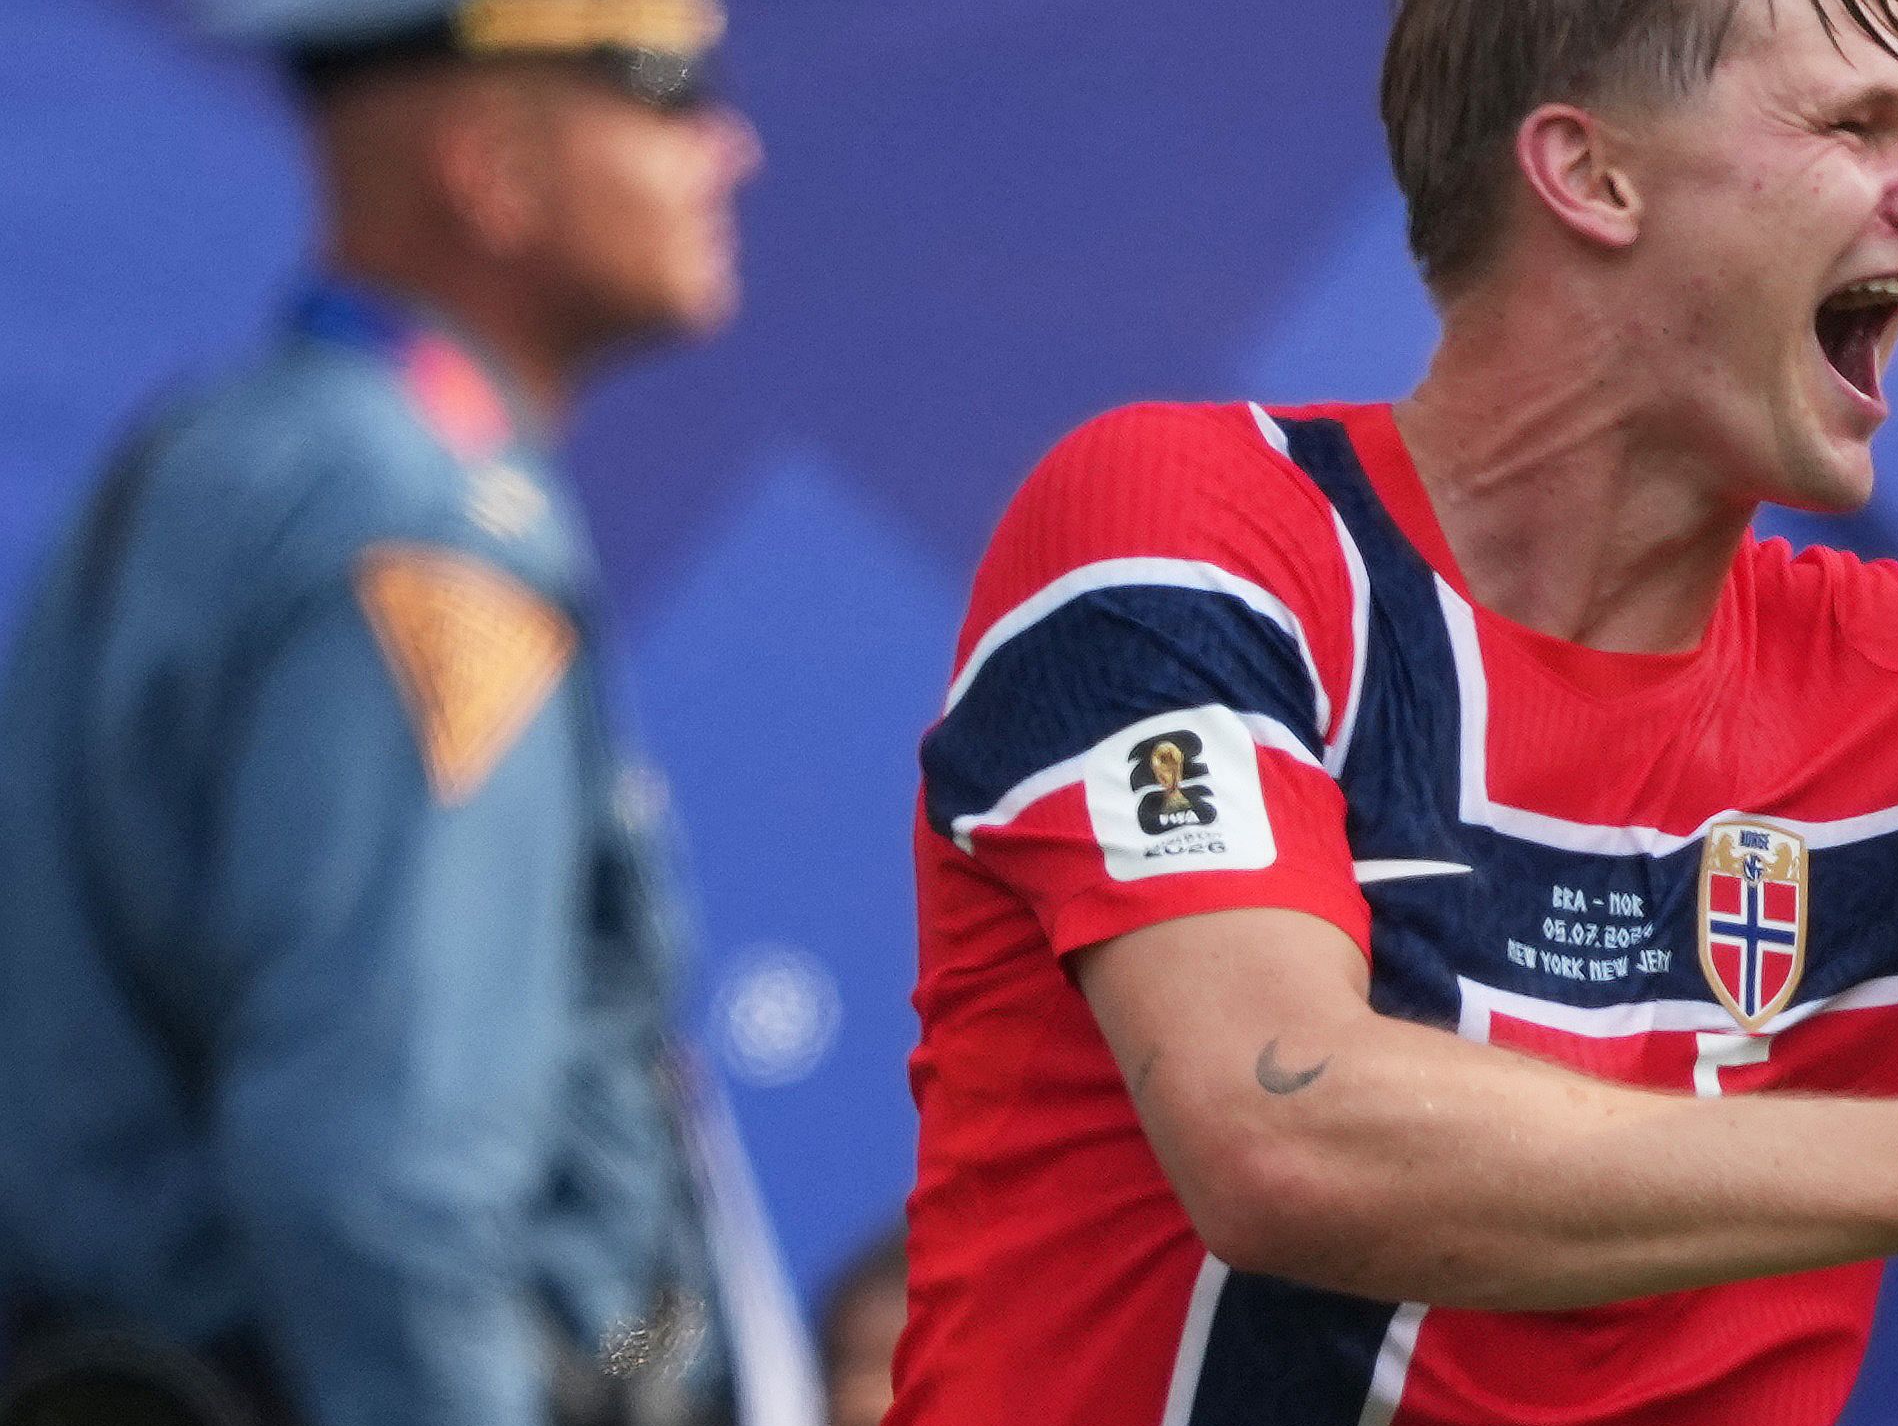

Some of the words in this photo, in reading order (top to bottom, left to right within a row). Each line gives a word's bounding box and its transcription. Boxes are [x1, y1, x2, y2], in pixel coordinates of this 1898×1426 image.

[1552, 884, 1589, 914] BRA
[1608, 890, 1645, 918] NOR
[1539, 948, 1587, 981] YORK
[1589, 954, 1629, 982] NEW
